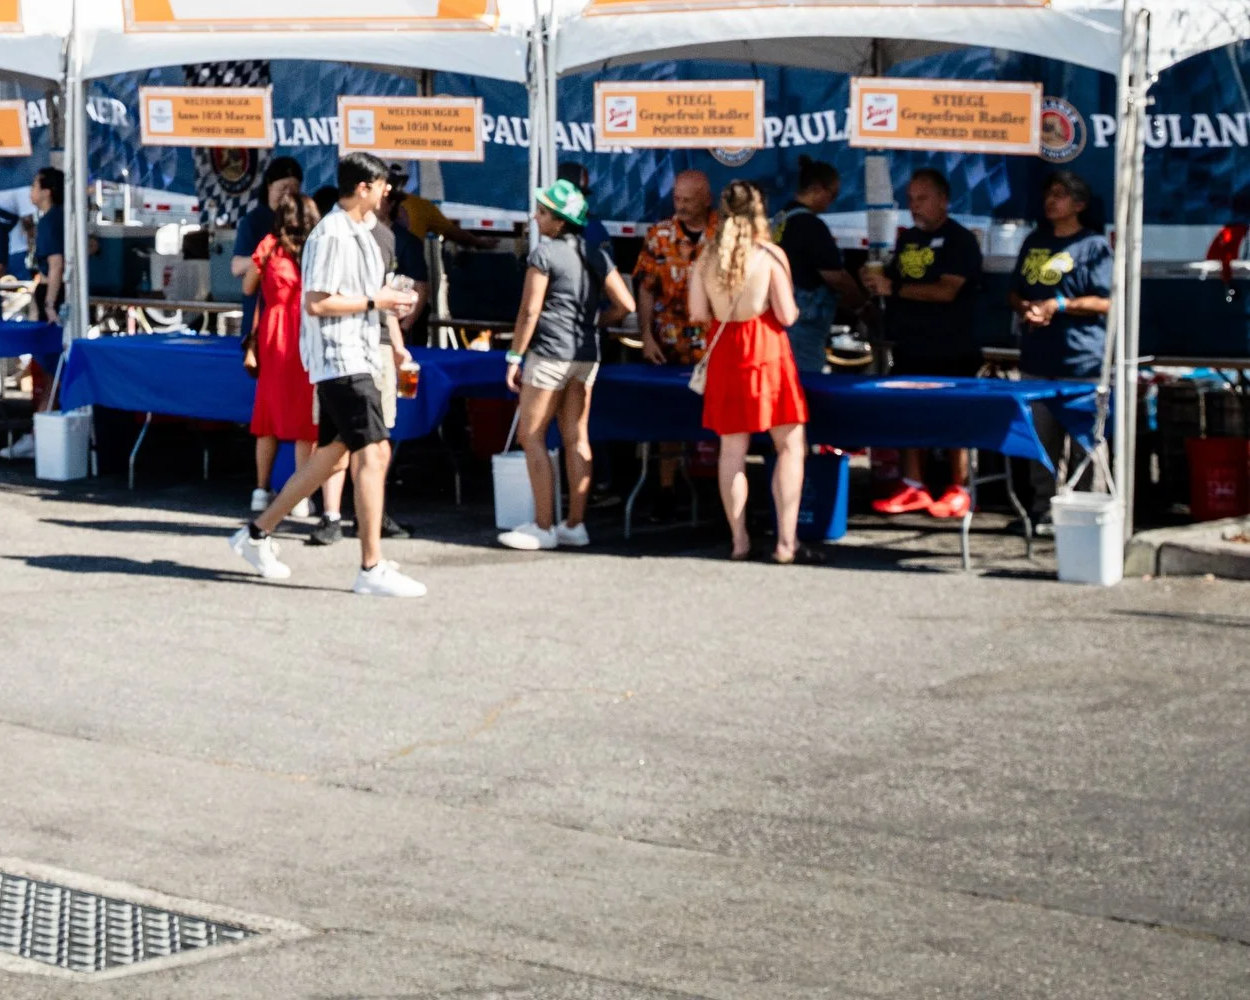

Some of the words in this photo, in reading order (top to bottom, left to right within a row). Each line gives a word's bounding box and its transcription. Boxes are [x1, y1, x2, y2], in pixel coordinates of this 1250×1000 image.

[184, 96, 250, 106] WELTENBURGER
[667, 94, 715, 106] STIEGL
[932, 94, 987, 107] STIEGL
[387, 108, 459, 117] WELTENBURGER
[639, 108, 704, 122] Grapefruit
[708, 108, 749, 121] Radler
[901, 109, 974, 124] Grapefruit
[979, 110, 1026, 124] Radler
[379, 122, 403, 131] Anno
[653, 125, 699, 135] POURED
[702, 125, 734, 135] HERE
[915, 126, 968, 138] POURED
[972, 128, 1008, 140] HERE
[394, 138, 427, 146] POURED
[430, 138, 454, 147] HERE
